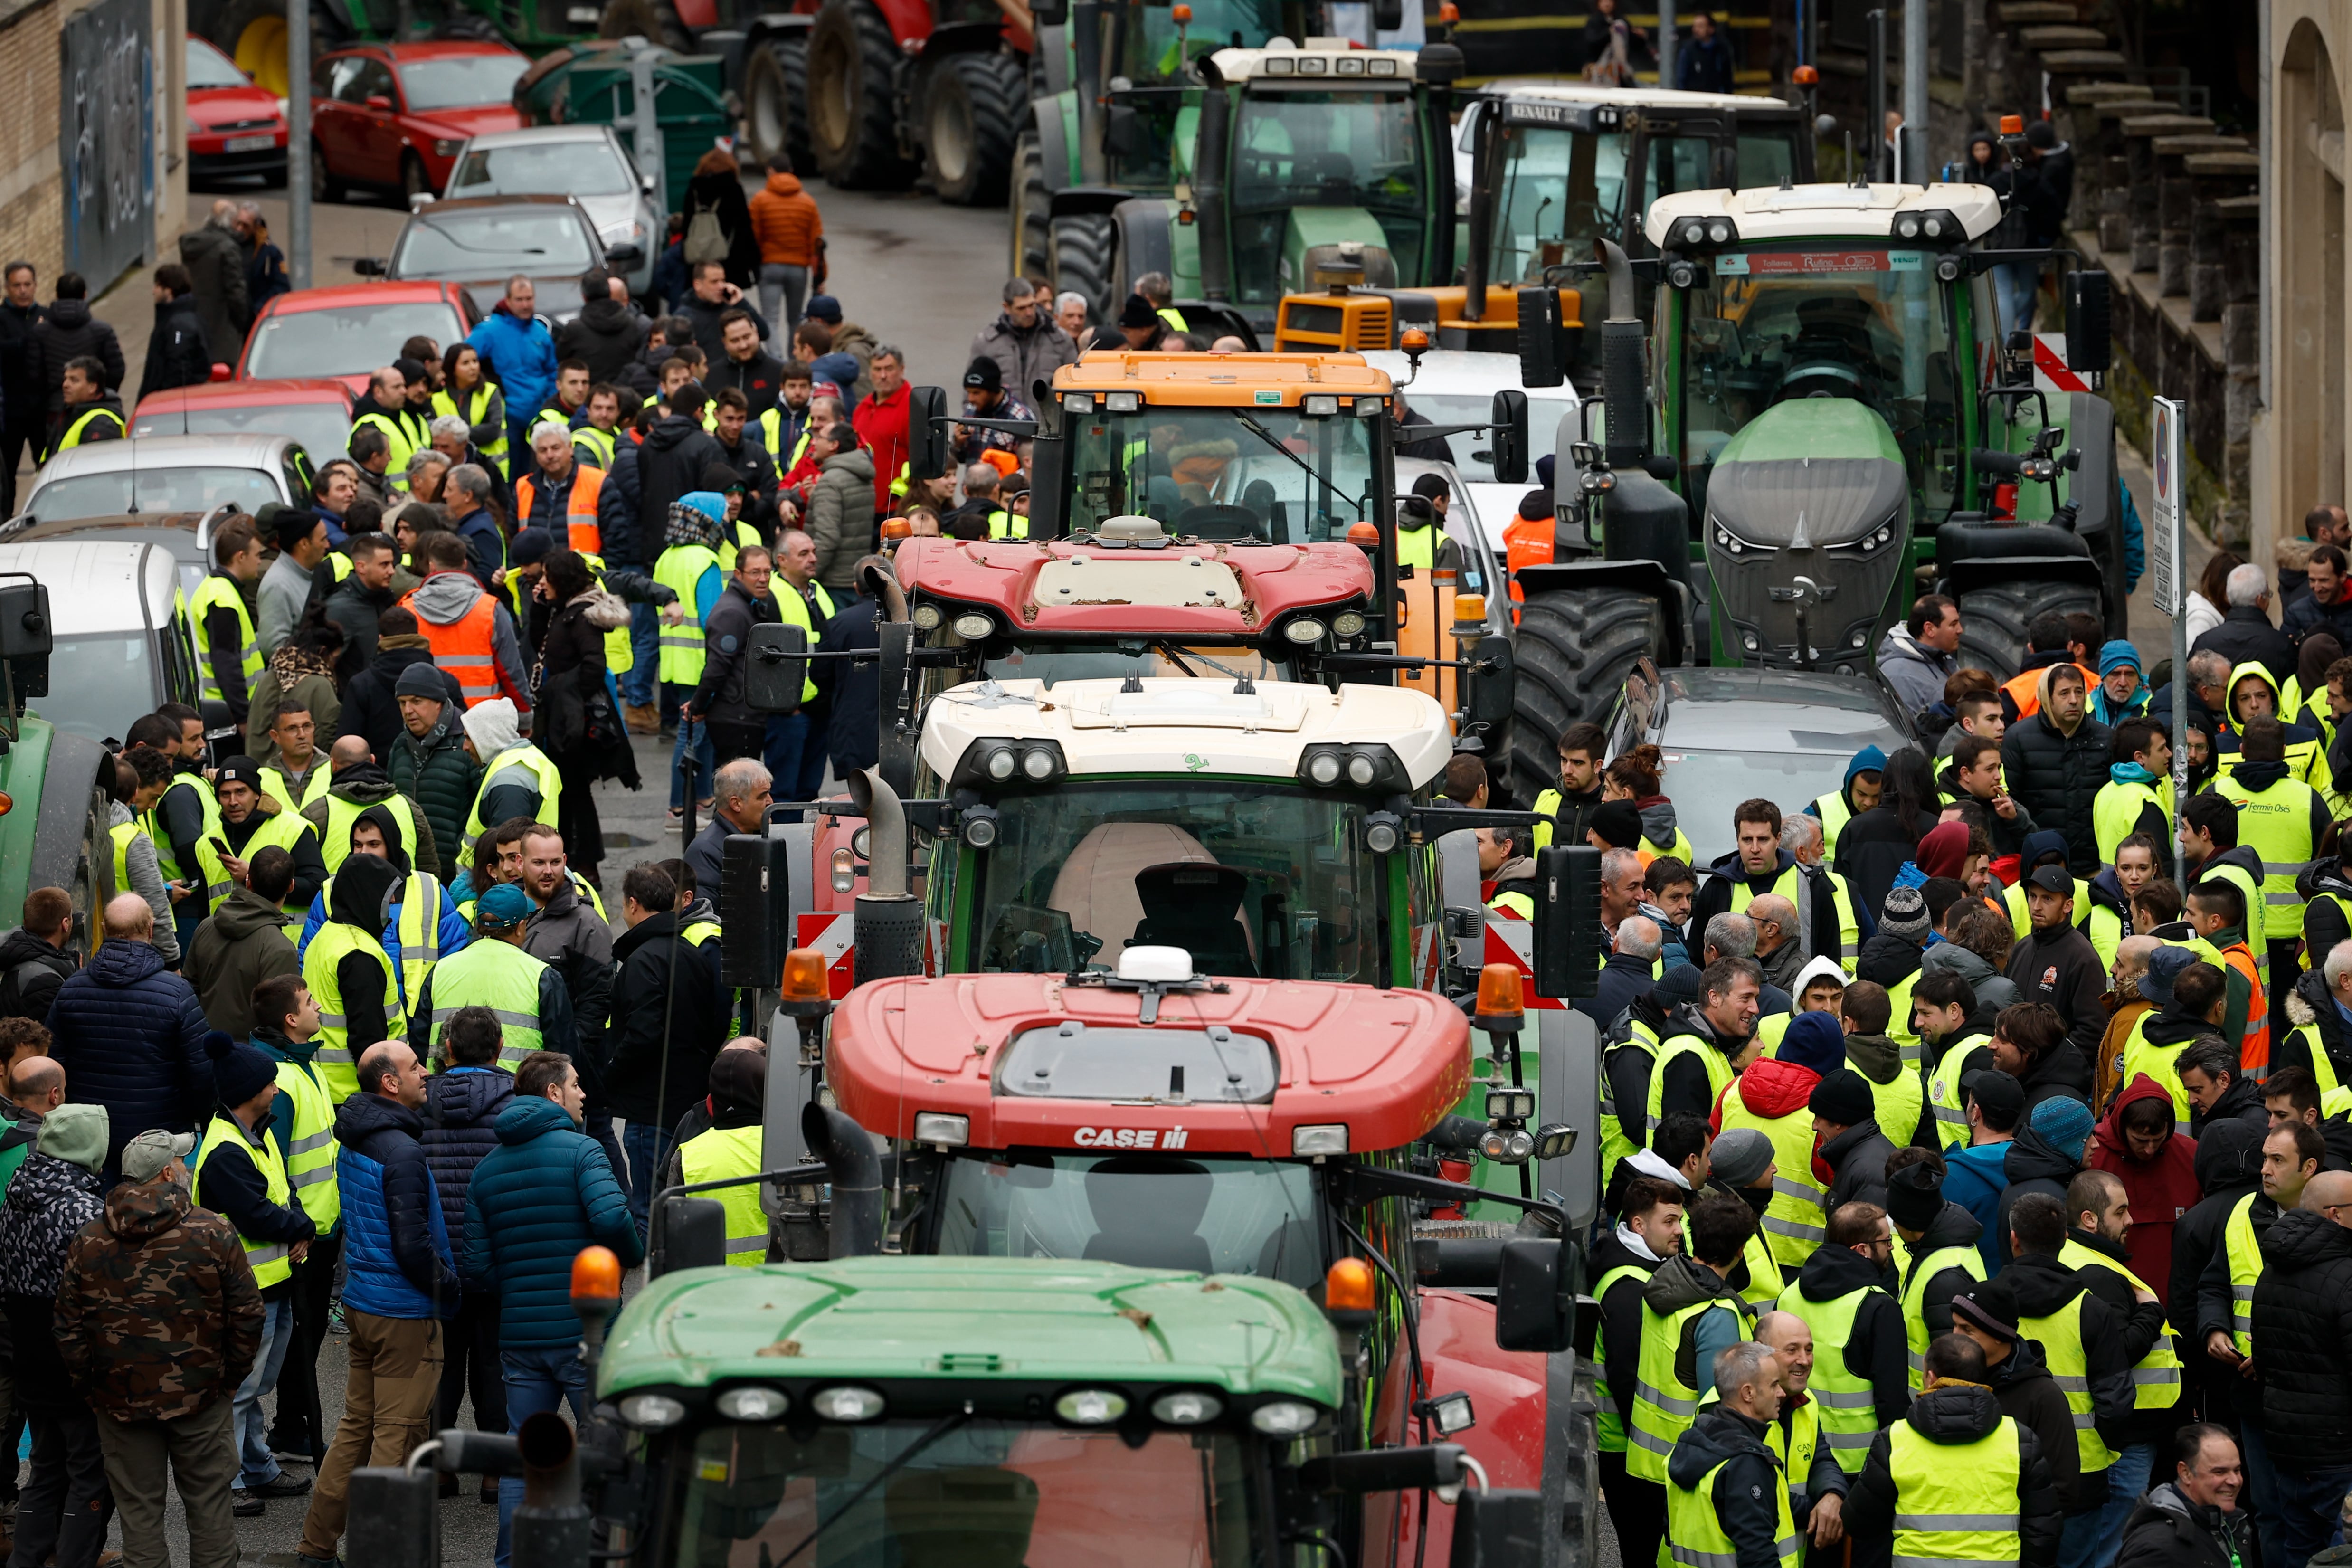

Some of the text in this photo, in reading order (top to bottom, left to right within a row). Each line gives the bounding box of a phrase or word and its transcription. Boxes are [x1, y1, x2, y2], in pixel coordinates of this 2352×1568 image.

[1512, 103, 1562, 122] RENAULT
[1768, 587, 1837, 601] FET
[1074, 1126, 1157, 1148] CASE
